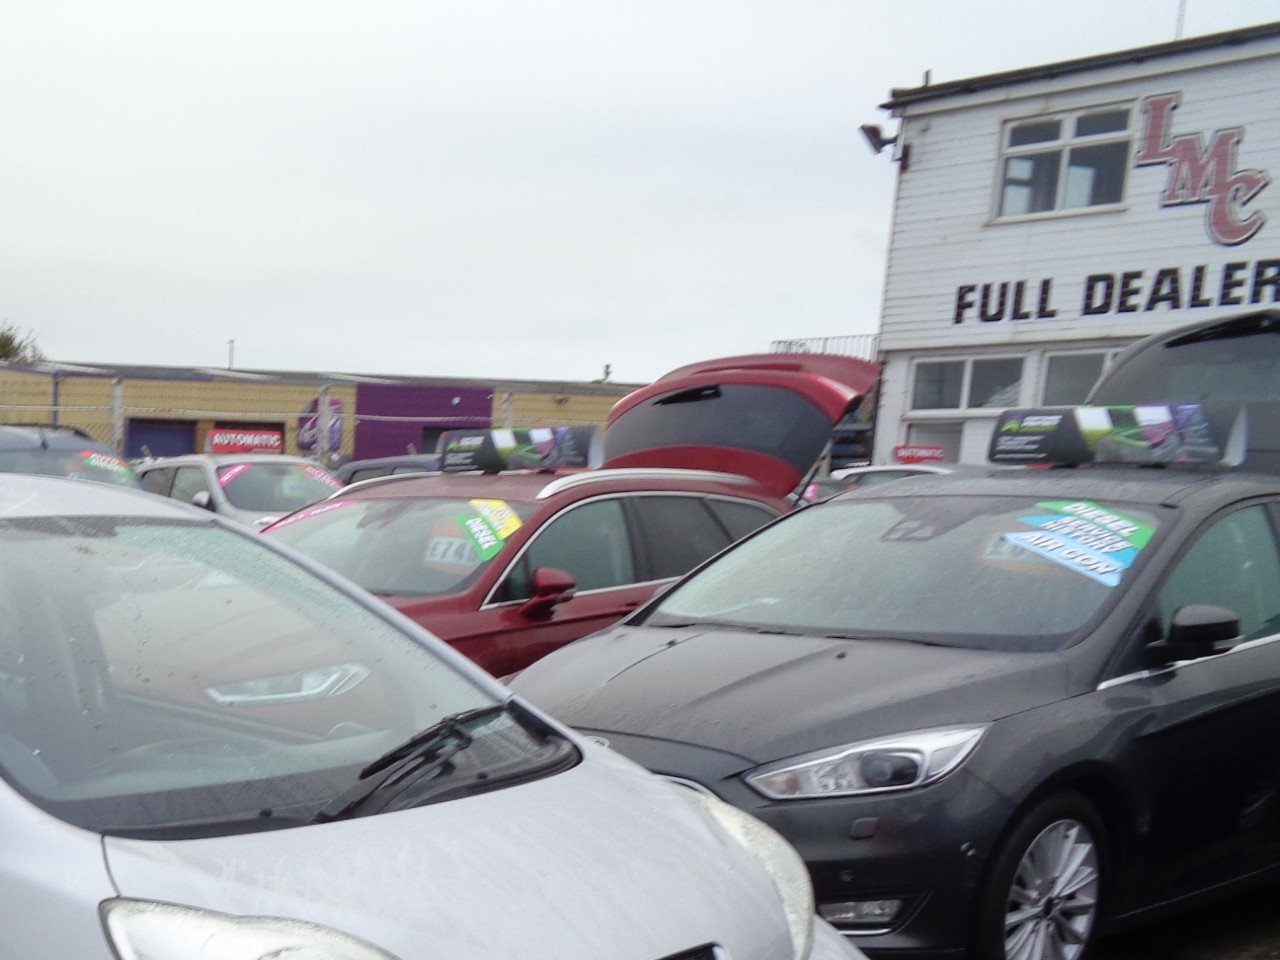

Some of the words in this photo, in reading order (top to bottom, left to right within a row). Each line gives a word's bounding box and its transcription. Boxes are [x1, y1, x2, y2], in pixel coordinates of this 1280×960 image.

[1132, 90, 1271, 246] LMC
[953, 277, 1057, 324] FULL
[1081, 258, 1280, 317] DEALER
[213, 432, 281, 446] AUTOMATIC
[464, 517, 498, 550] DIESEL
[1061, 501, 1140, 538] DIESEL
[1020, 532, 1067, 553] AIR
[1059, 547, 1119, 576] CON
